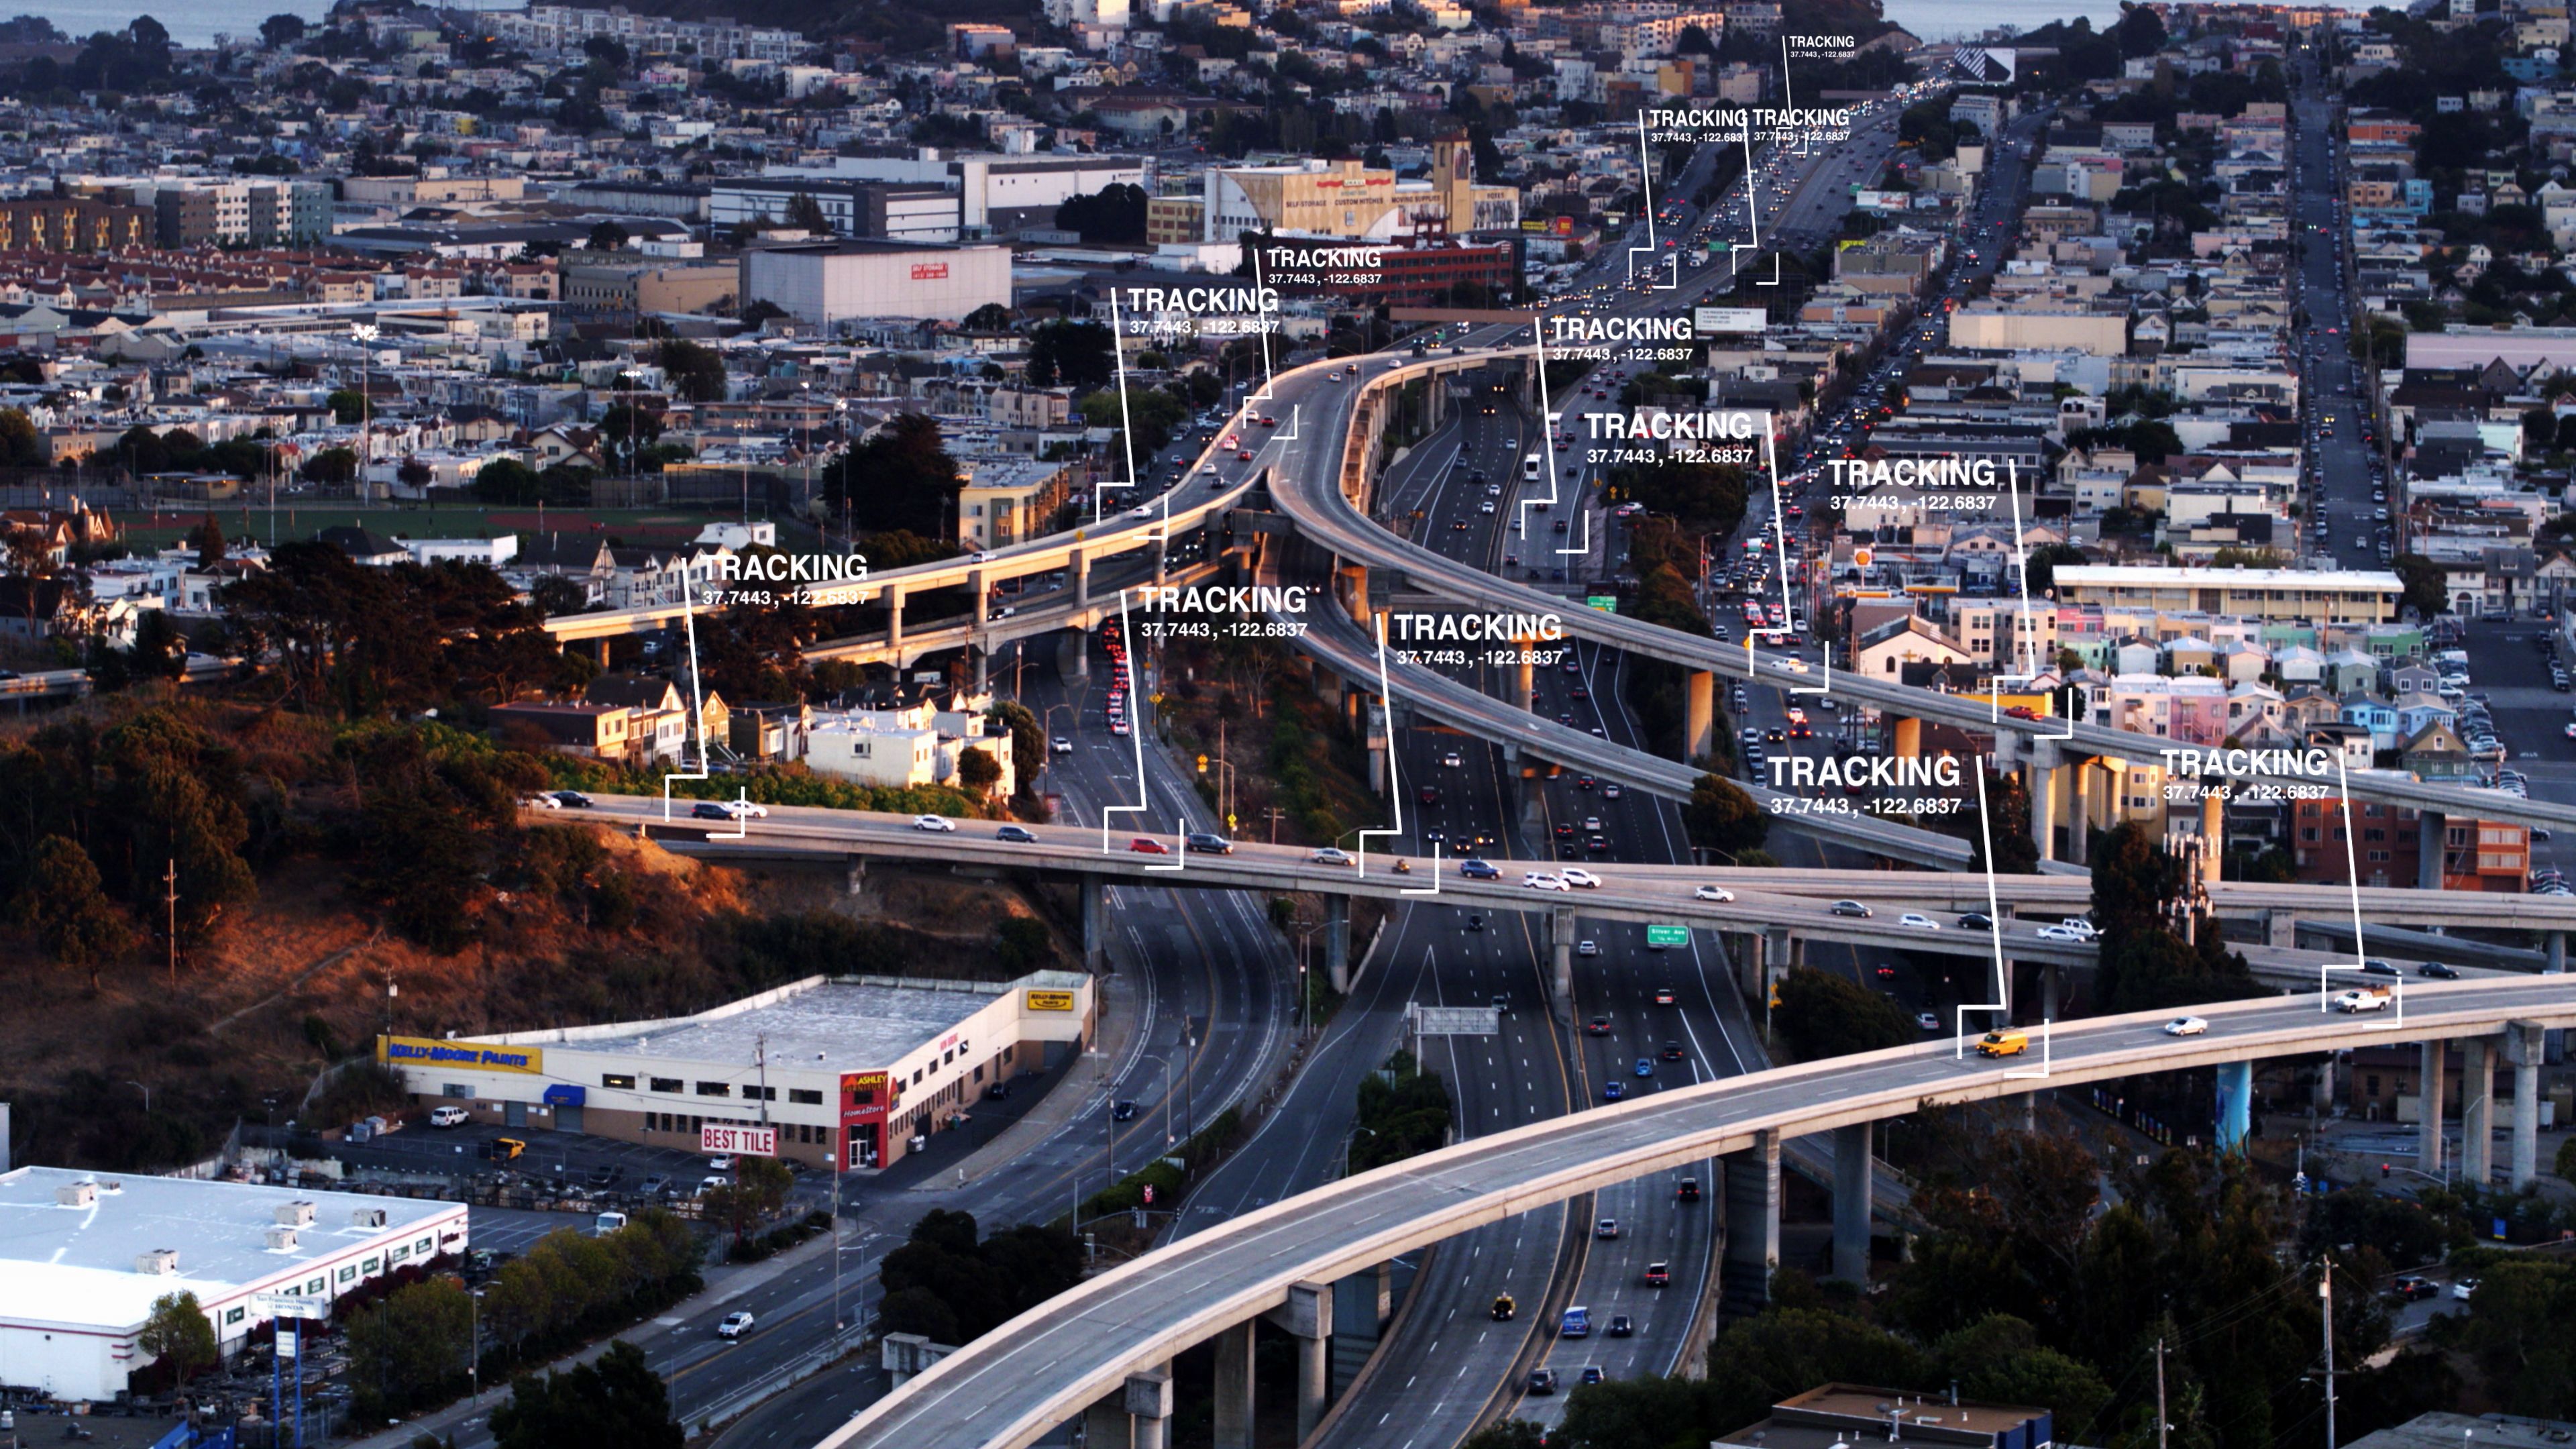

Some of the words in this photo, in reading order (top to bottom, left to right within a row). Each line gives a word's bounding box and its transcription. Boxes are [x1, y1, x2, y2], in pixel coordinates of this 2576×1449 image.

[1415, 195, 1440, 203] SUPPLIES
[389, 1043, 479, 1062] KELLY-MOORE
[480, 1050, 528, 1067] PAINTS
[857, 1075, 888, 1085] ASHLEY
[843, 1105, 885, 1118] HomeStore
[704, 1128, 737, 1150] BEST
[742, 1131, 771, 1152] TILE
